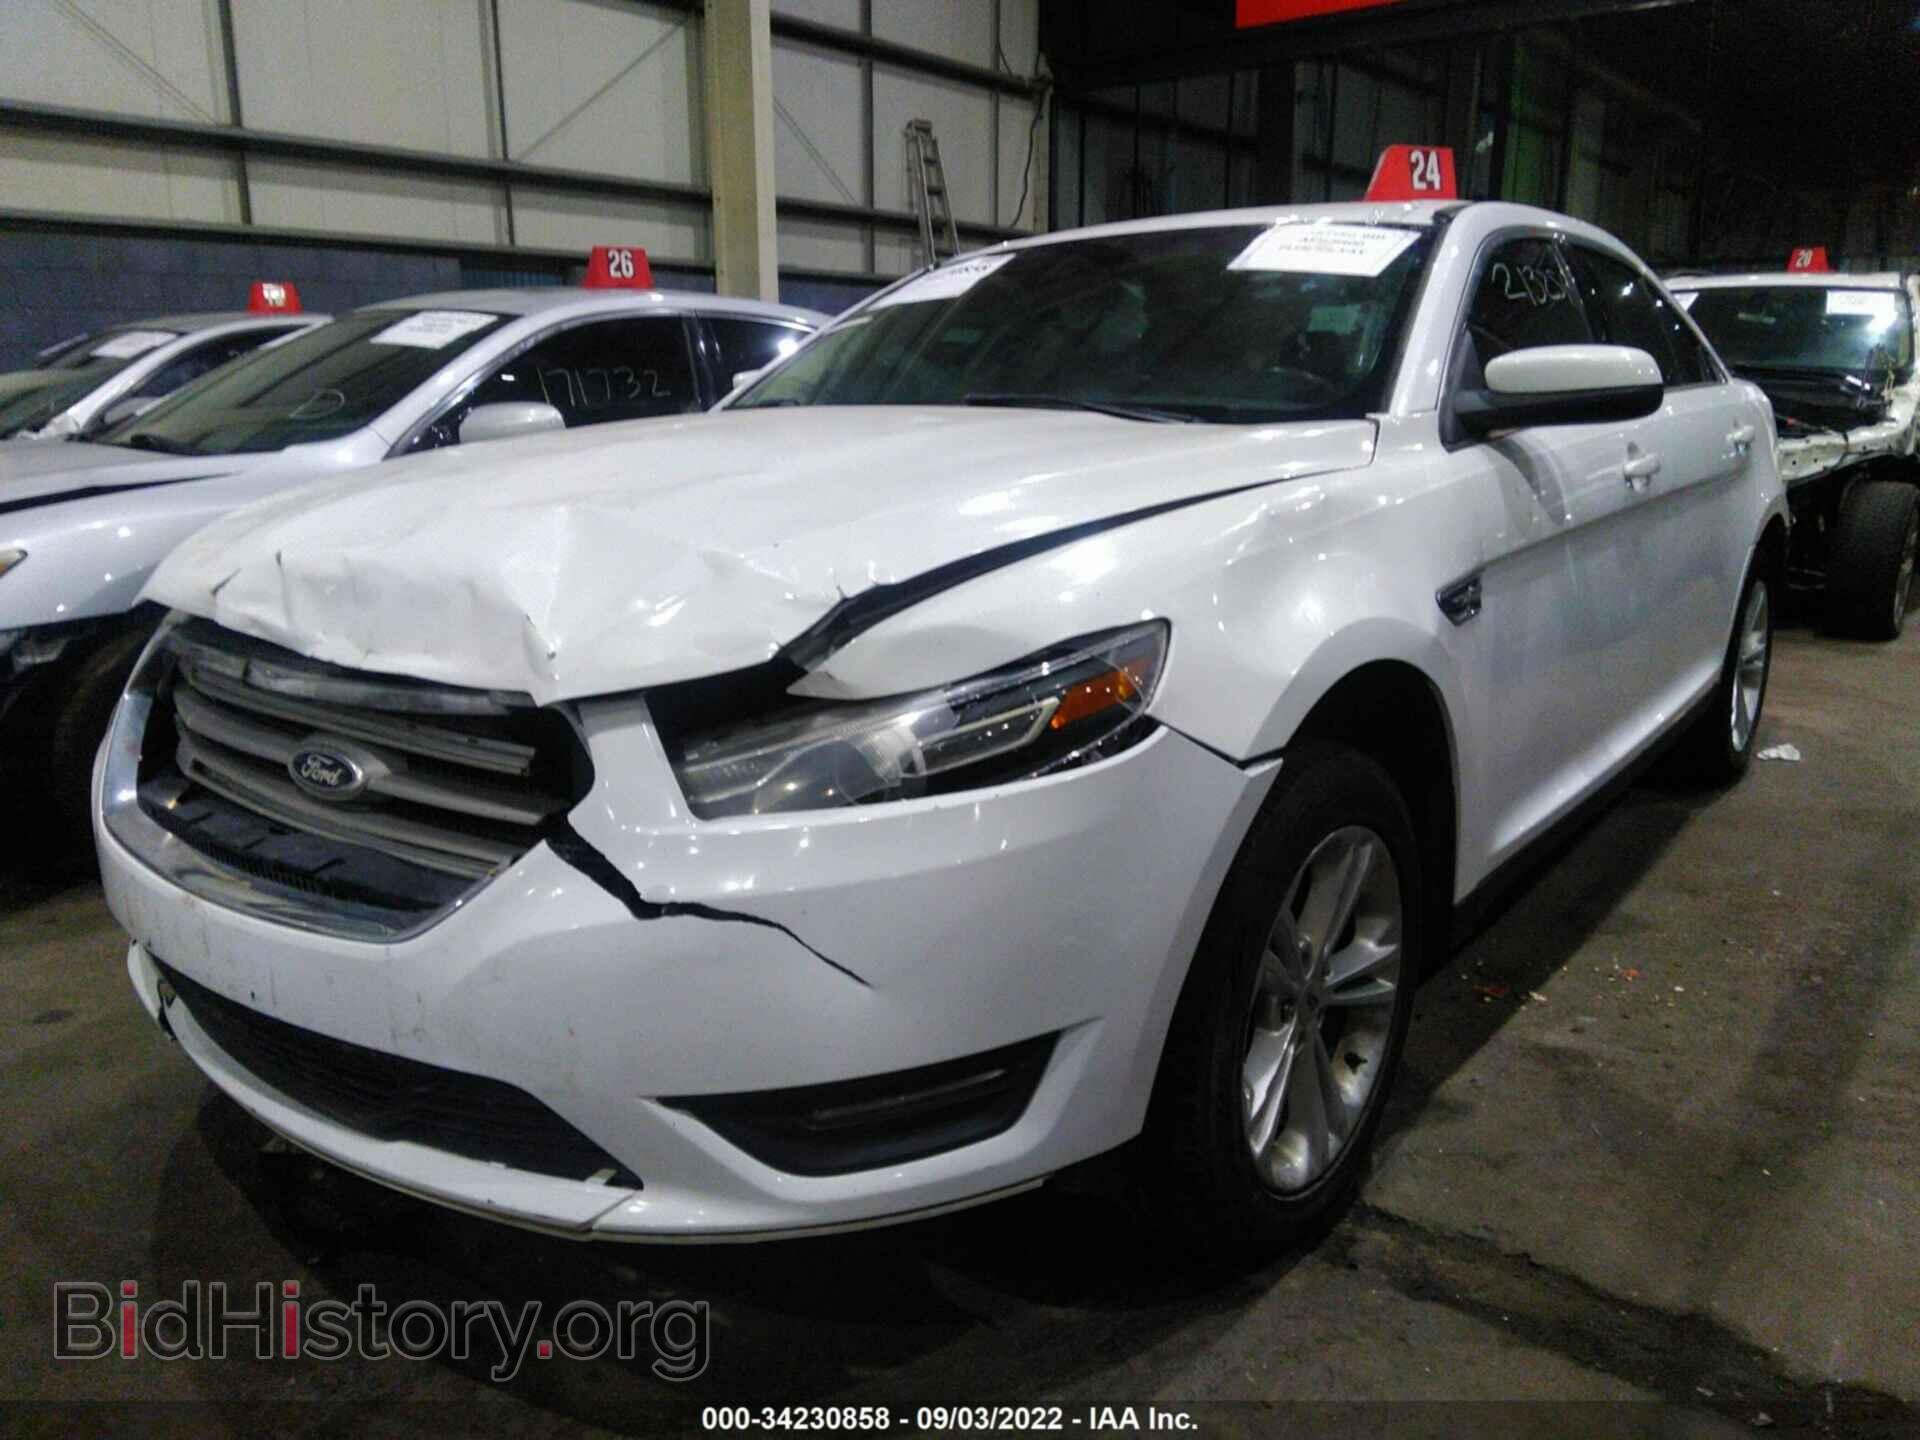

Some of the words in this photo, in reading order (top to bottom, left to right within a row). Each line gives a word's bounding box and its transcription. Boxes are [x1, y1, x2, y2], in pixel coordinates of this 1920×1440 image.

[1410, 150, 1440, 191] 24
[608, 249, 634, 279] 26
[301, 754, 342, 786] Ford
